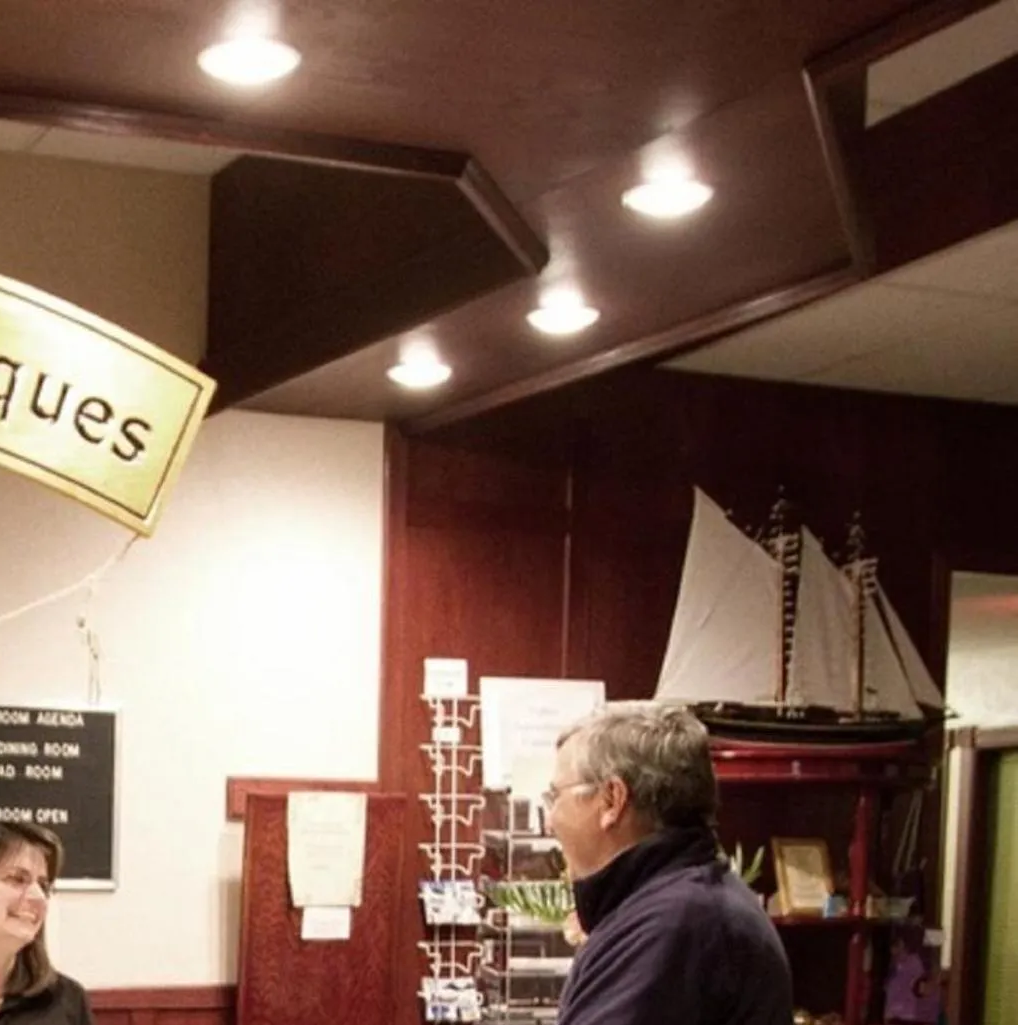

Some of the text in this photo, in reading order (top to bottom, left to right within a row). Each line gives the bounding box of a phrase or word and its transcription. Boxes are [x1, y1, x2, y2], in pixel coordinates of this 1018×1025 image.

[36, 711, 84, 727] AGENDA
[43, 742, 80, 758] ROOM
[25, 763, 63, 780] ROOM
[35, 808, 69, 825] OPEN
